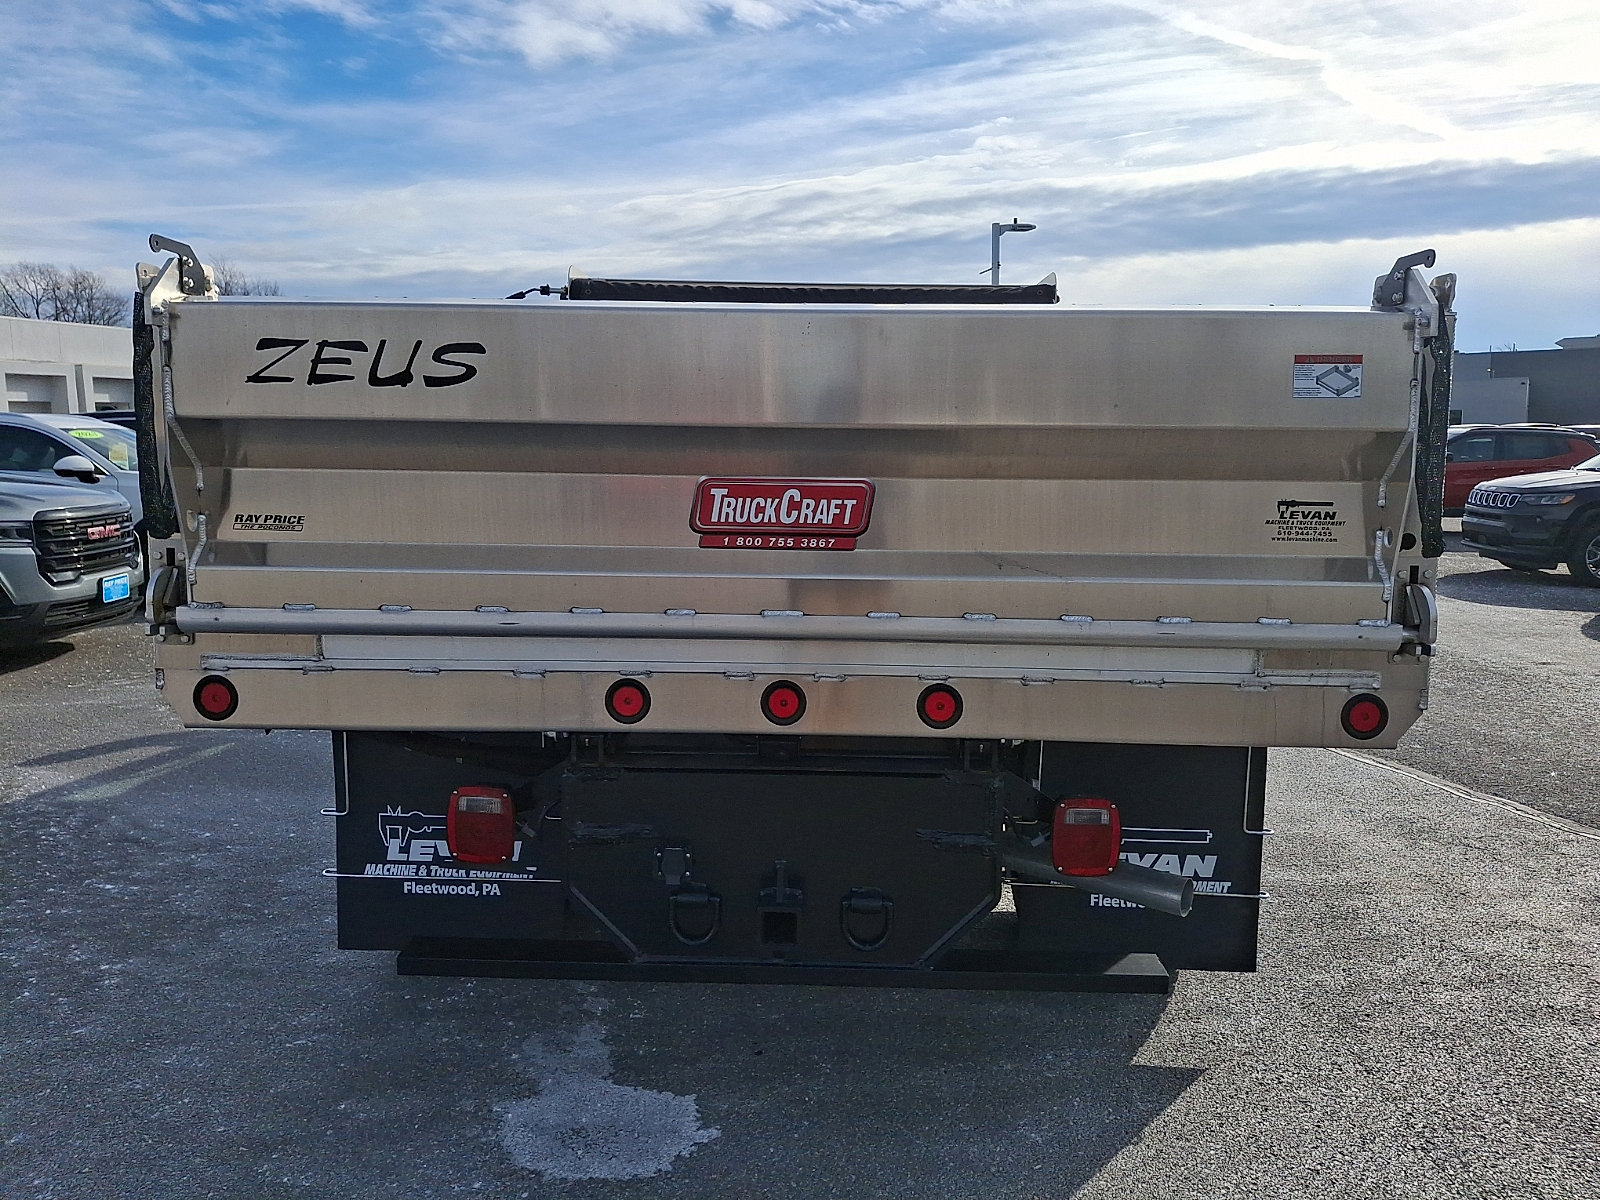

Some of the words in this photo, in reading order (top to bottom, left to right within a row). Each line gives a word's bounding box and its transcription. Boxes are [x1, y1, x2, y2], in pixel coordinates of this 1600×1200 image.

[245, 338, 487, 388] ZEUS
[710, 488, 857, 525] TRUCKCRAFT
[234, 514, 262, 523] RAY
[264, 514, 305, 525] PRICE
[1279, 510, 1337, 520] LEVAN
[723, 537, 729, 545] 1
[736, 537, 762, 546] 800
[769, 538, 794, 546] 755
[800, 538, 836, 547] 3867
[364, 863, 417, 877] MACHINE
[418, 864, 427, 877] &
[1119, 852, 1218, 878] VAN
[403, 881, 480, 897] Fleetwood,
[482, 883, 501, 896] PA
